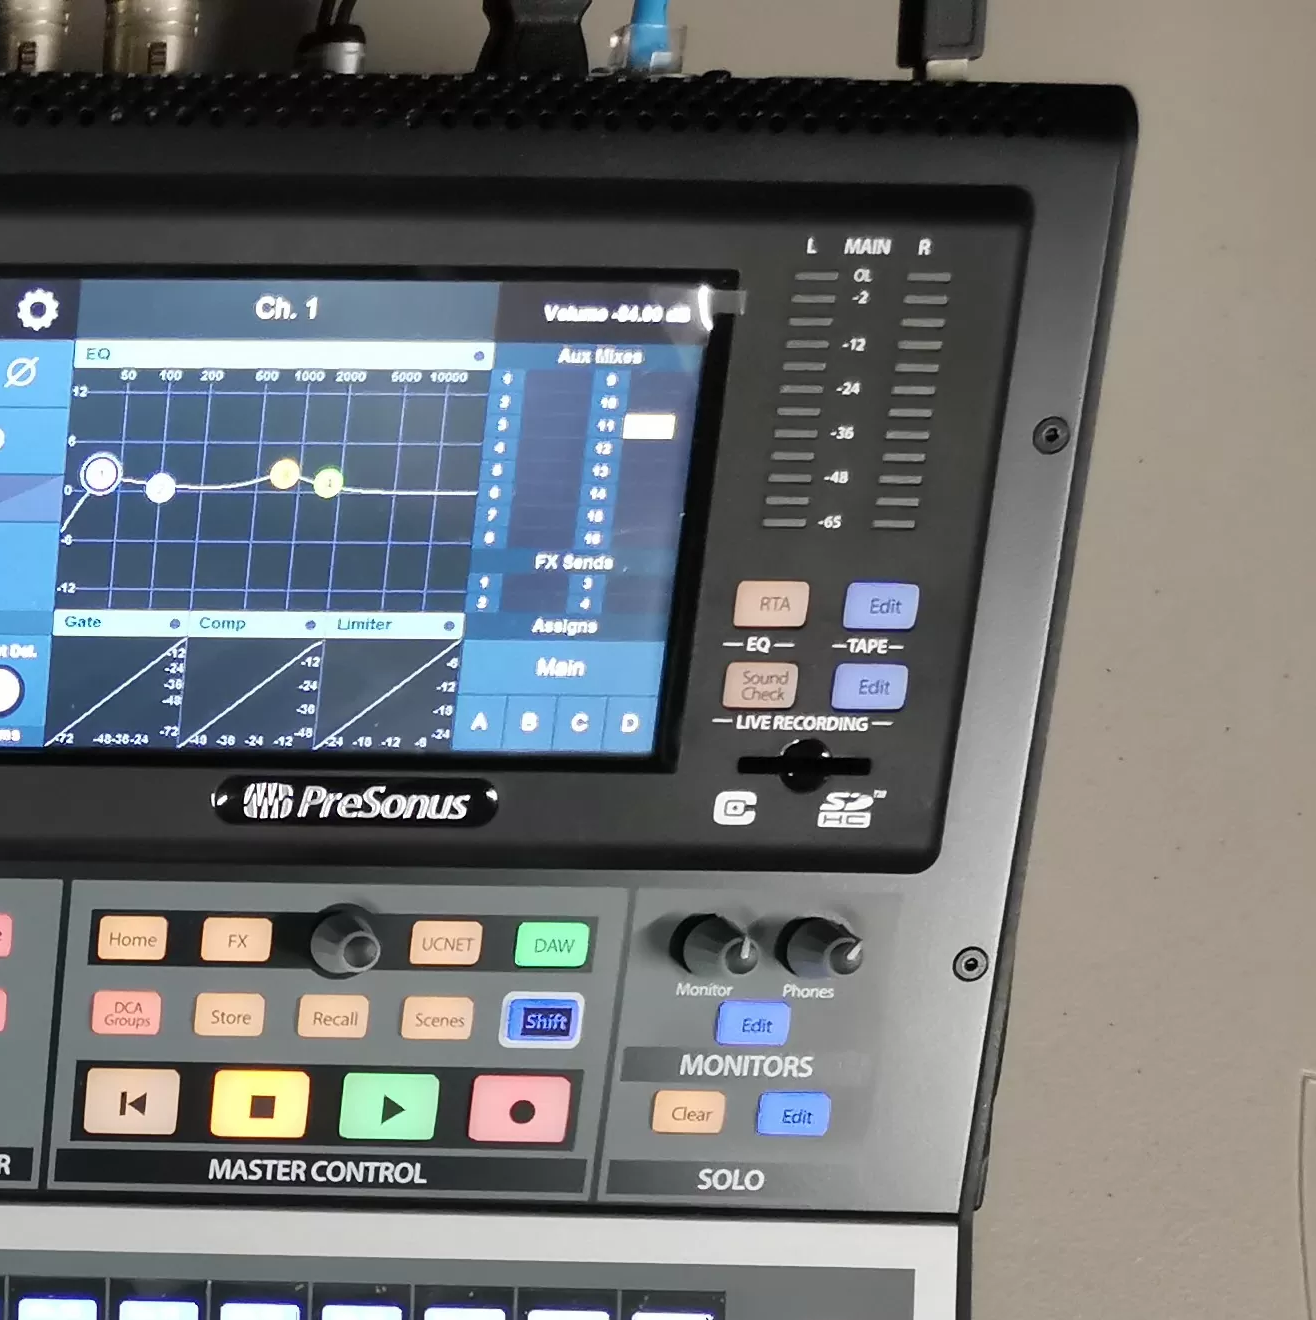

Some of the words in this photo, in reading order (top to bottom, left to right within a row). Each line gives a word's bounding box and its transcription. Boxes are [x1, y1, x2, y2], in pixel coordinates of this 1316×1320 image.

[806, 236, 818, 255] L
[843, 236, 893, 256] MAIN
[917, 237, 933, 256] R
[254, 293, 298, 321] Ch.
[305, 295, 319, 320] 1
[841, 337, 867, 352] -12
[85, 347, 111, 361] EQ
[557, 344, 593, 364] Aux
[594, 345, 645, 365] Mixes
[817, 514, 843, 529] -65
[534, 552, 559, 573] FX
[562, 552, 615, 571] Sends
[759, 595, 791, 612] RTA
[64, 615, 102, 628] Gate
[199, 616, 247, 632] Comp
[336, 618, 393, 631] Limiter
[530, 616, 599, 637] Assigns
[745, 635, 772, 654] EQ
[845, 637, 891, 655] TAPE
[534, 656, 587, 679] Main
[742, 669, 790, 686] Sound
[741, 685, 786, 702] Check
[735, 714, 773, 731] LIVE
[772, 714, 869, 732] RECORDING
[296, 785, 472, 820] PreSonus
[109, 931, 158, 948] Home
[227, 933, 249, 949] FX
[421, 936, 476, 953] UCNET
[534, 937, 576, 954] DAW
[675, 982, 734, 998] Monitor
[781, 983, 835, 1000] Phones
[114, 1001, 143, 1015] DCA
[103, 1011, 151, 1030] Groups
[210, 1009, 252, 1026] Store
[312, 1011, 359, 1027] Recall
[414, 1012, 466, 1028] Scenes
[523, 1011, 568, 1031] Shift
[741, 1017, 773, 1034] Edit
[677, 1053, 815, 1079] MONITORS
[671, 1106, 714, 1122] Clear
[781, 1108, 814, 1125] Edit
[207, 1158, 307, 1182] MASTER
[310, 1159, 428, 1184] CONTROL
[696, 1167, 768, 1191] SOLO
